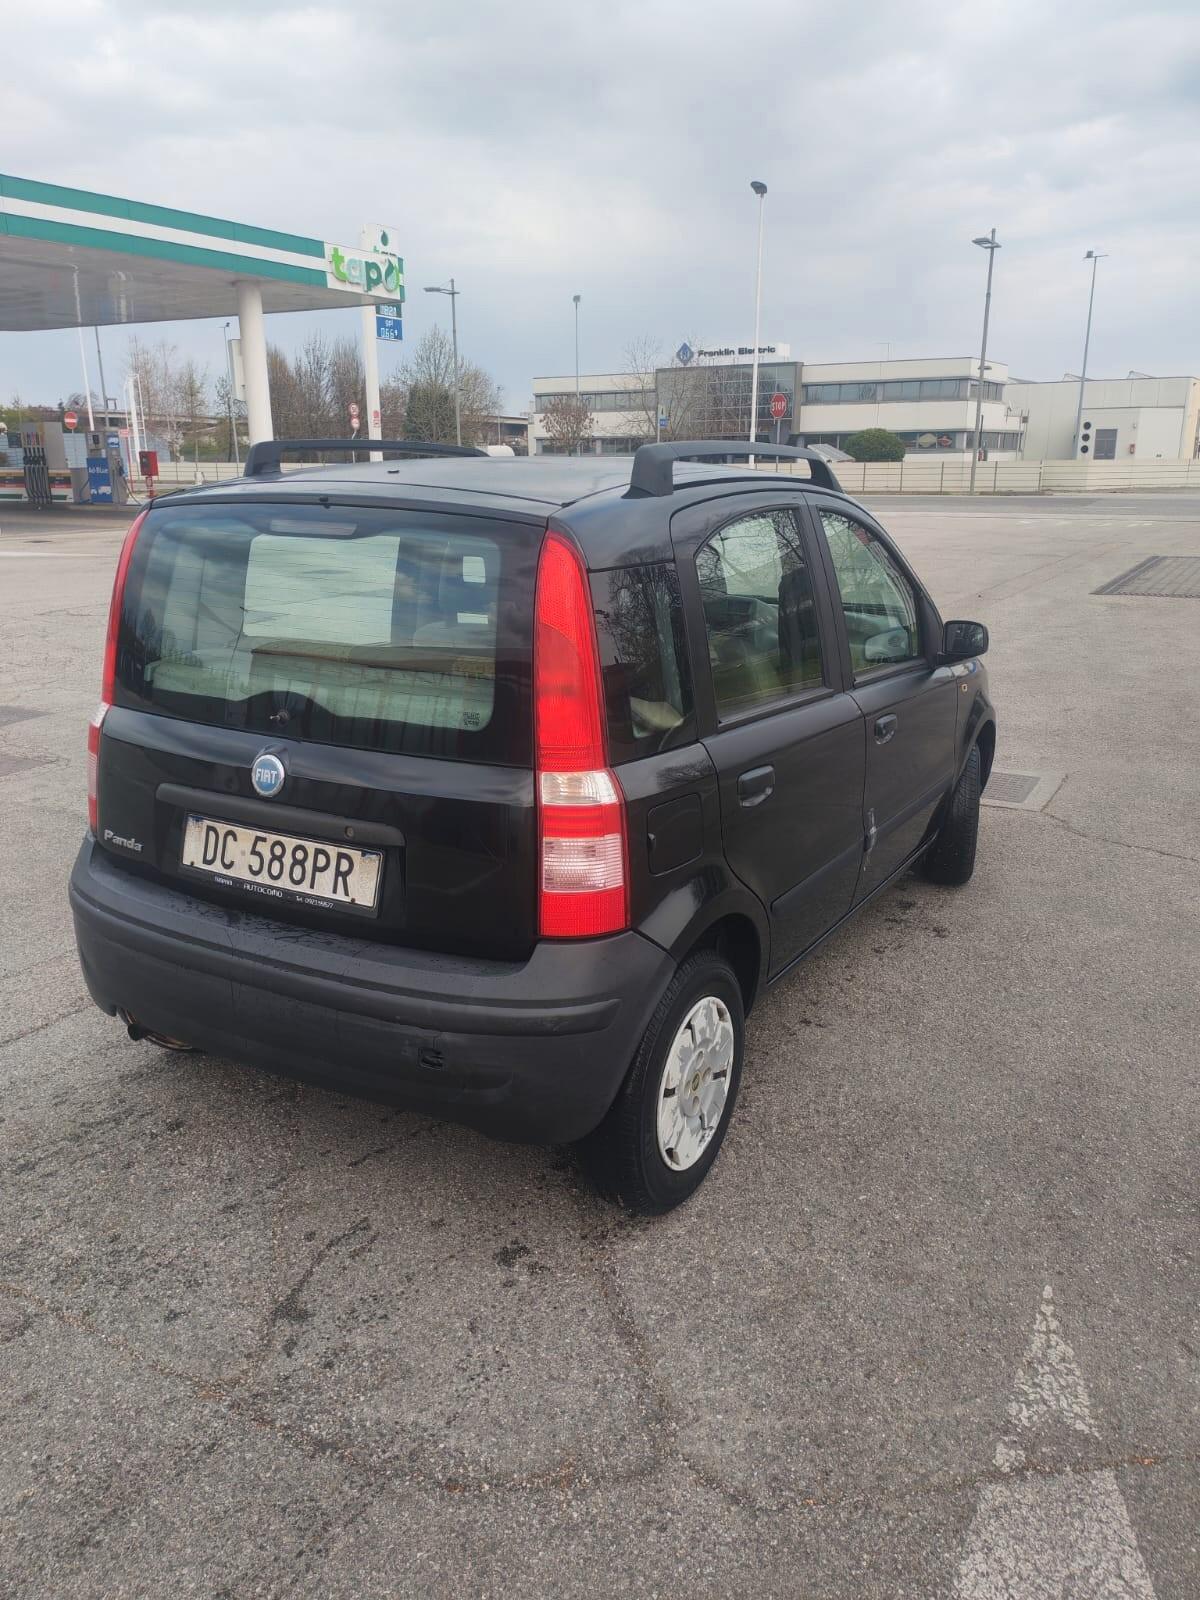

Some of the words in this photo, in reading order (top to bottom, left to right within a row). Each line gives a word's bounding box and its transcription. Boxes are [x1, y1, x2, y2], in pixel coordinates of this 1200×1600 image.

[698, 348, 735, 357] Franklin
[771, 401, 786, 412] STOP
[255, 767, 278, 784] FIAT
[104, 829, 145, 852] Panda
[202, 825, 237, 871] DC
[248, 836, 354, 897] 588PR
